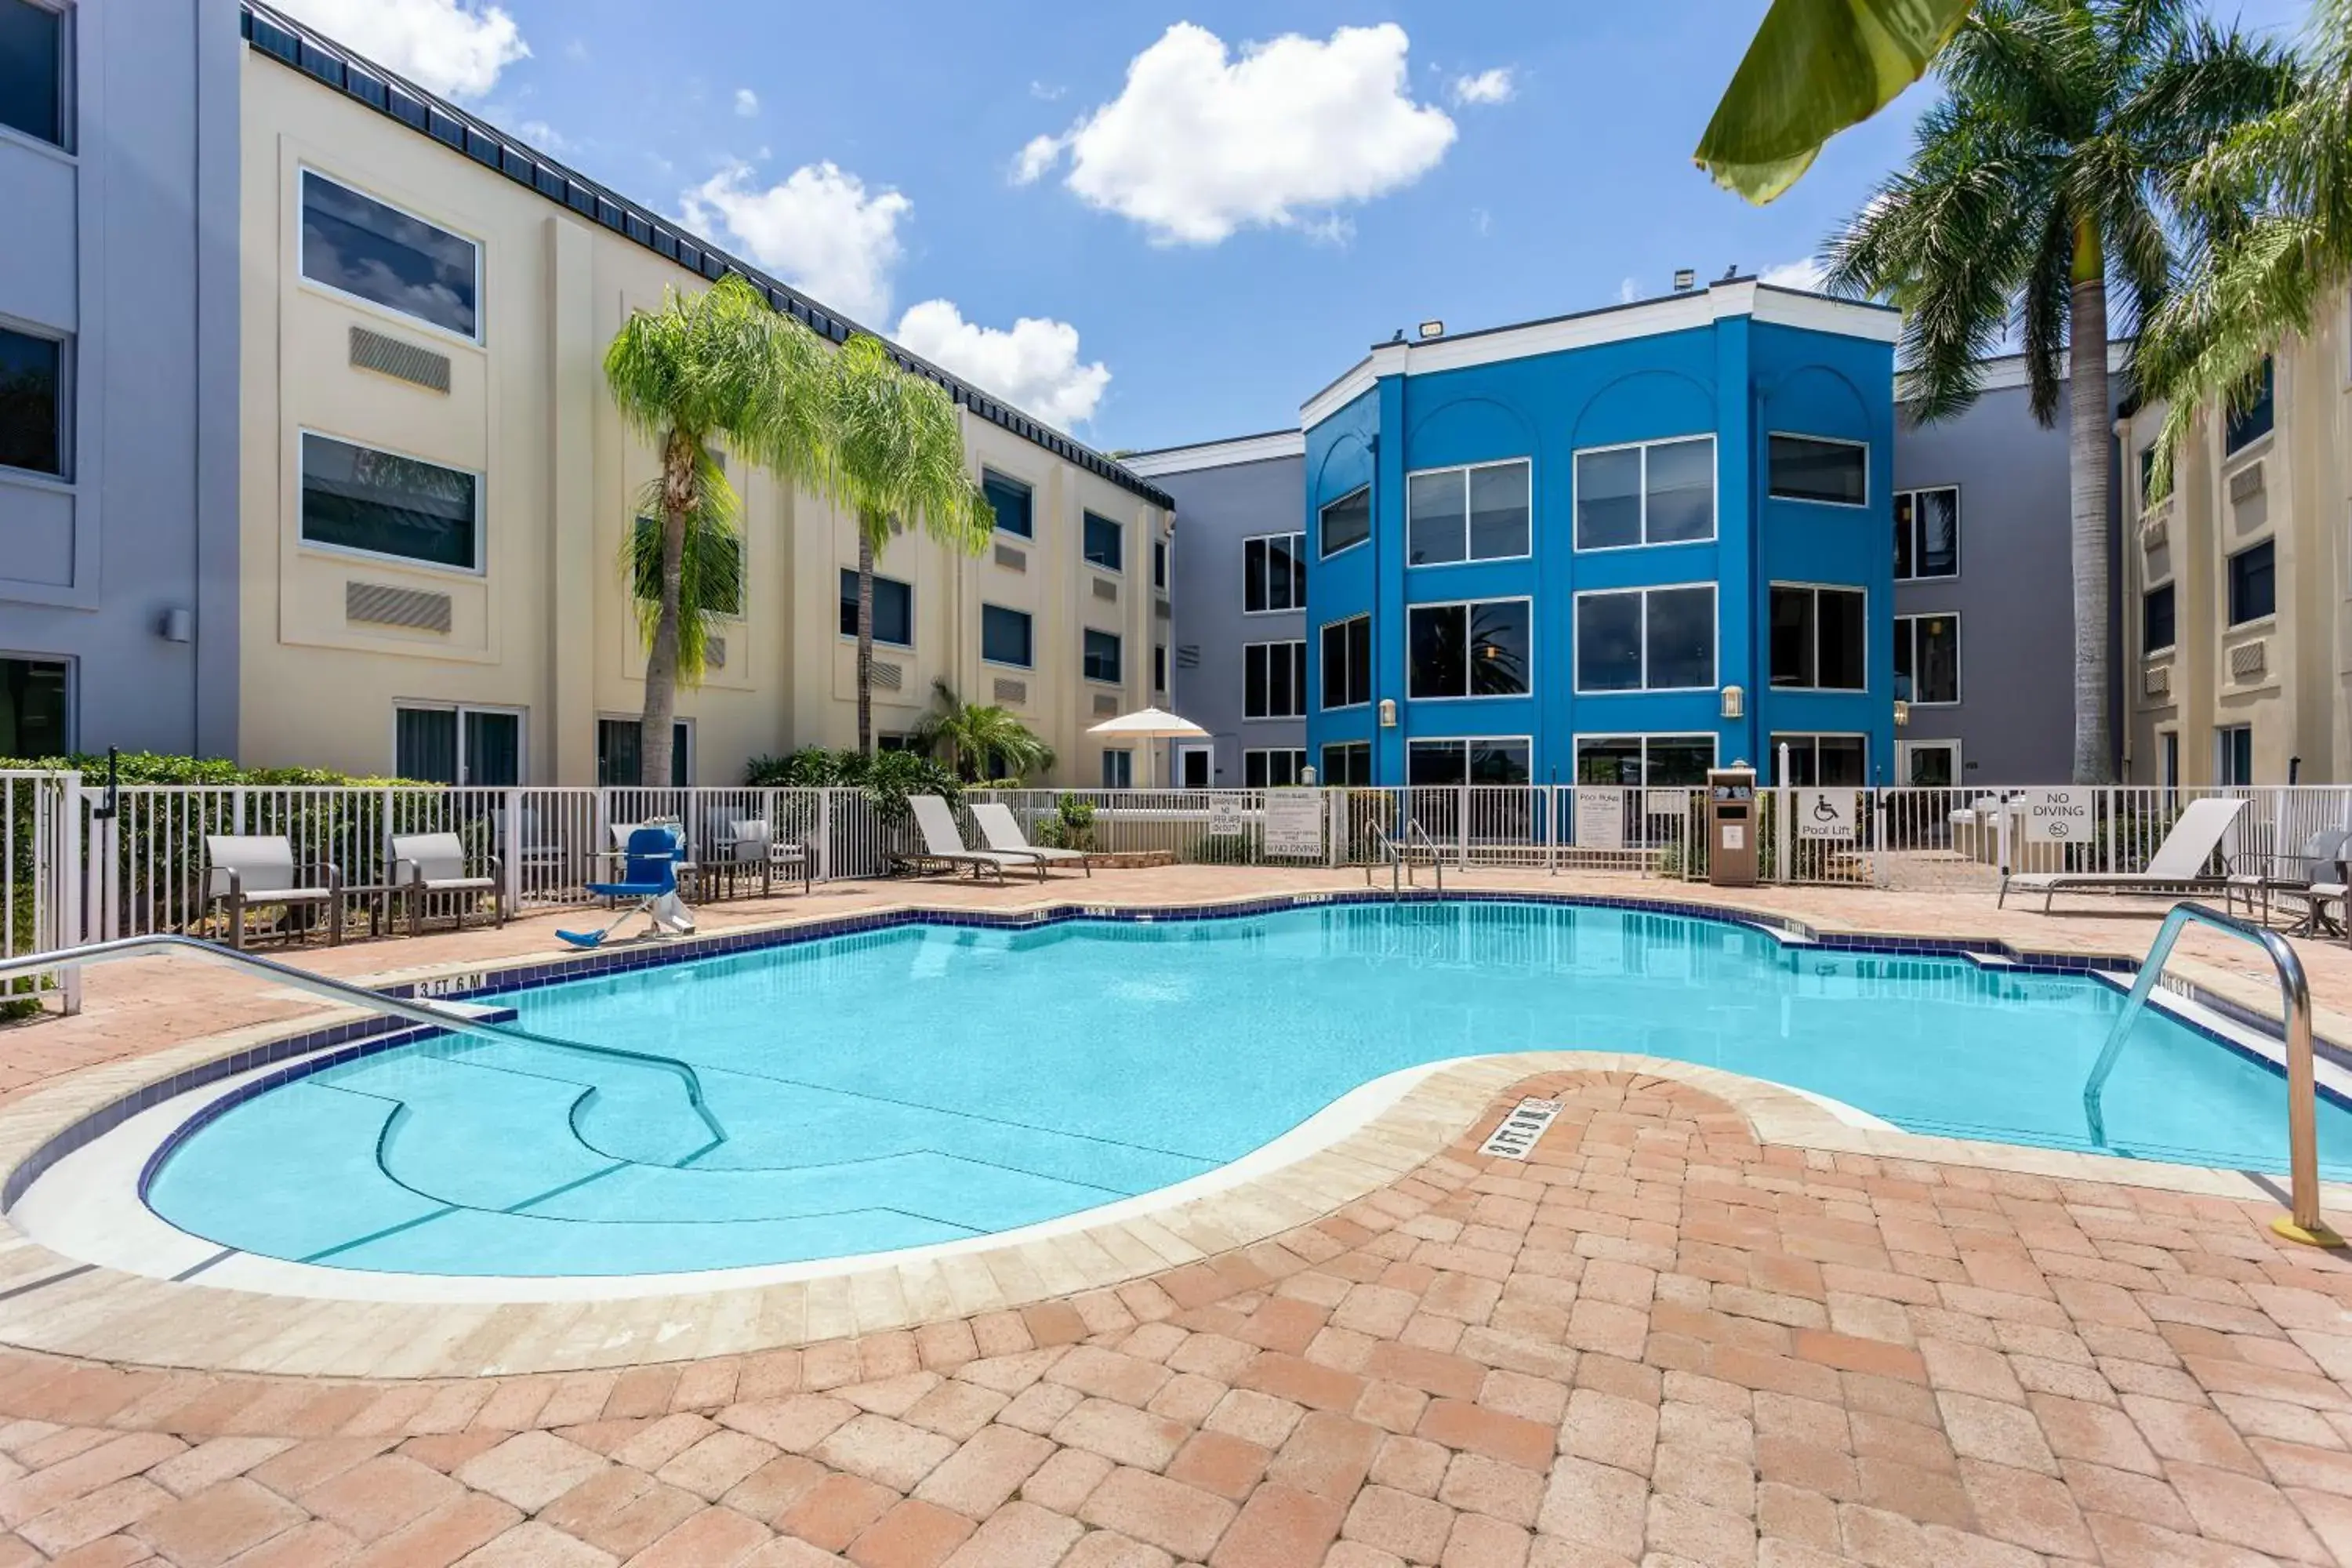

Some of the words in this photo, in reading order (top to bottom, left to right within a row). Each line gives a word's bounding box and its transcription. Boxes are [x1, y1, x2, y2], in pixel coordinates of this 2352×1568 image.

[2047, 793, 2070, 804] NO
[2033, 805, 2085, 816] DIVING
[1802, 825, 1829, 836] Pool
[1832, 825, 1850, 835] Lift
[1290, 844, 1319, 853] DIVING
[420, 982, 428, 997] 3
[435, 979, 448, 994] FT
[1495, 1130, 1534, 1145] FT
[1489, 1145, 1521, 1154] 3
